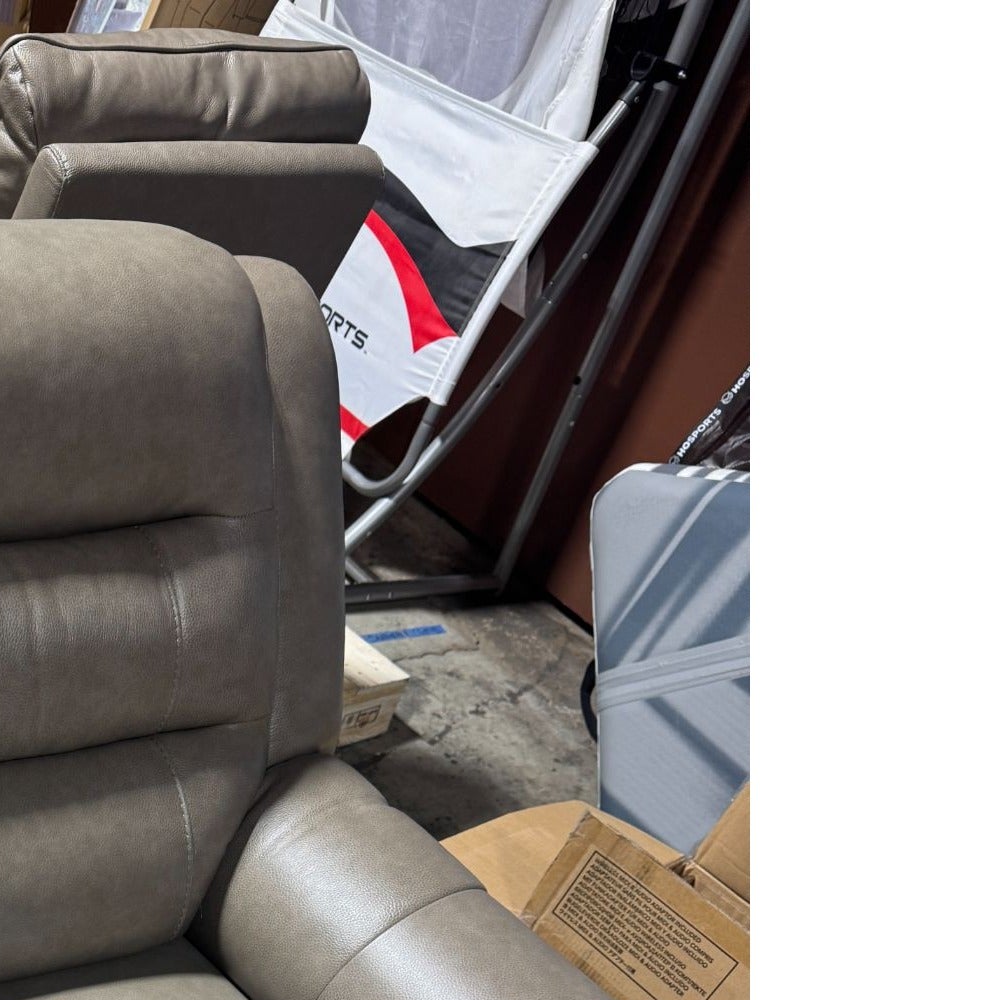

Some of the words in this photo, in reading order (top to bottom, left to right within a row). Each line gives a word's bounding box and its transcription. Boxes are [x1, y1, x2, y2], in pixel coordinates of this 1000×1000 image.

[677, 407, 722, 458] HOSPORTS
[623, 916, 642, 933] AUDIO
[651, 930, 670, 947] AUDIO
[664, 931, 684, 948] AUDIO
[672, 927, 691, 945] AUDIO
[689, 941, 714, 964] COMPRIS
[659, 974, 685, 997] ADAPTER
